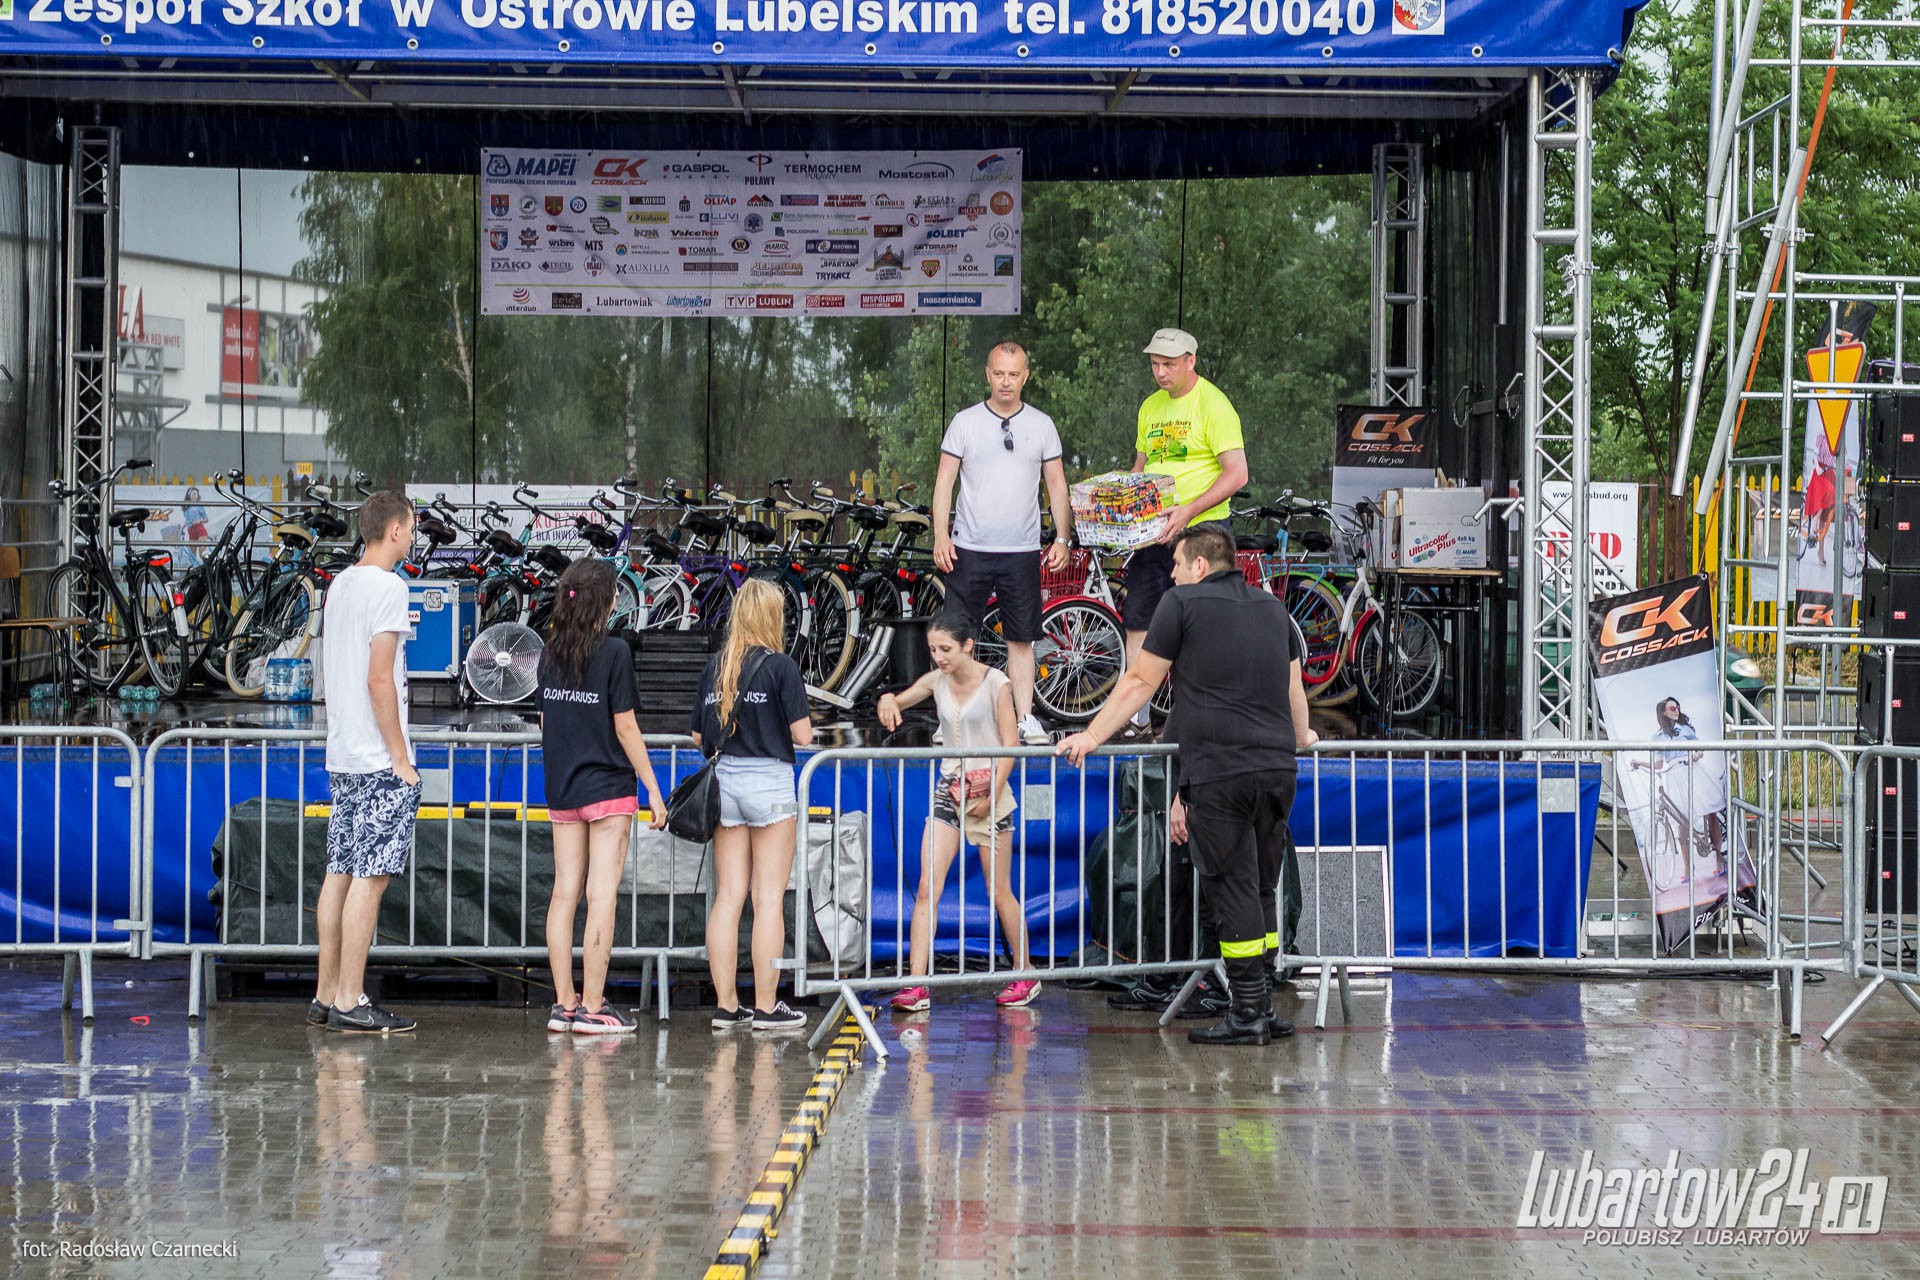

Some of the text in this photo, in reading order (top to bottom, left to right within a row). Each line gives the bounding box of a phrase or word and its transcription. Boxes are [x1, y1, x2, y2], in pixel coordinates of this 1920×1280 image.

[461, 0, 696, 31] Ostrowie
[715, 0, 978, 33] Lubelskim
[1003, 0, 1086, 35] tel.
[1101, 0, 1376, 36] 818520040
[515, 158, 577, 176] MAPEI
[593, 158, 649, 178] CK
[671, 164, 730, 173] GASPOL
[784, 164, 862, 174] TERMOCHEM
[879, 169, 949, 179] Mostostal
[745, 176, 775, 186] PUŁAWY
[926, 230, 967, 239] SOLBET
[548, 239, 575, 247] wibro
[585, 240, 603, 251] MTS
[491, 261, 532, 270] DAKO
[628, 264, 670, 272] AUXILIA
[596, 296, 653, 307] Lubartowiak
[727, 297, 792, 306] TVP LUBLIN
[862, 295, 903, 303] WSPÓLNOTA
[1351, 413, 1428, 442] CK
[1347, 442, 1425, 453] COSSACK
[1366, 455, 1405, 466] Fit for you
[1408, 530, 1451, 557] Ultracolor
[1437, 537, 1457, 552] Plus
[1601, 585, 1701, 648] CK
[1600, 625, 1710, 665] COSSACK
